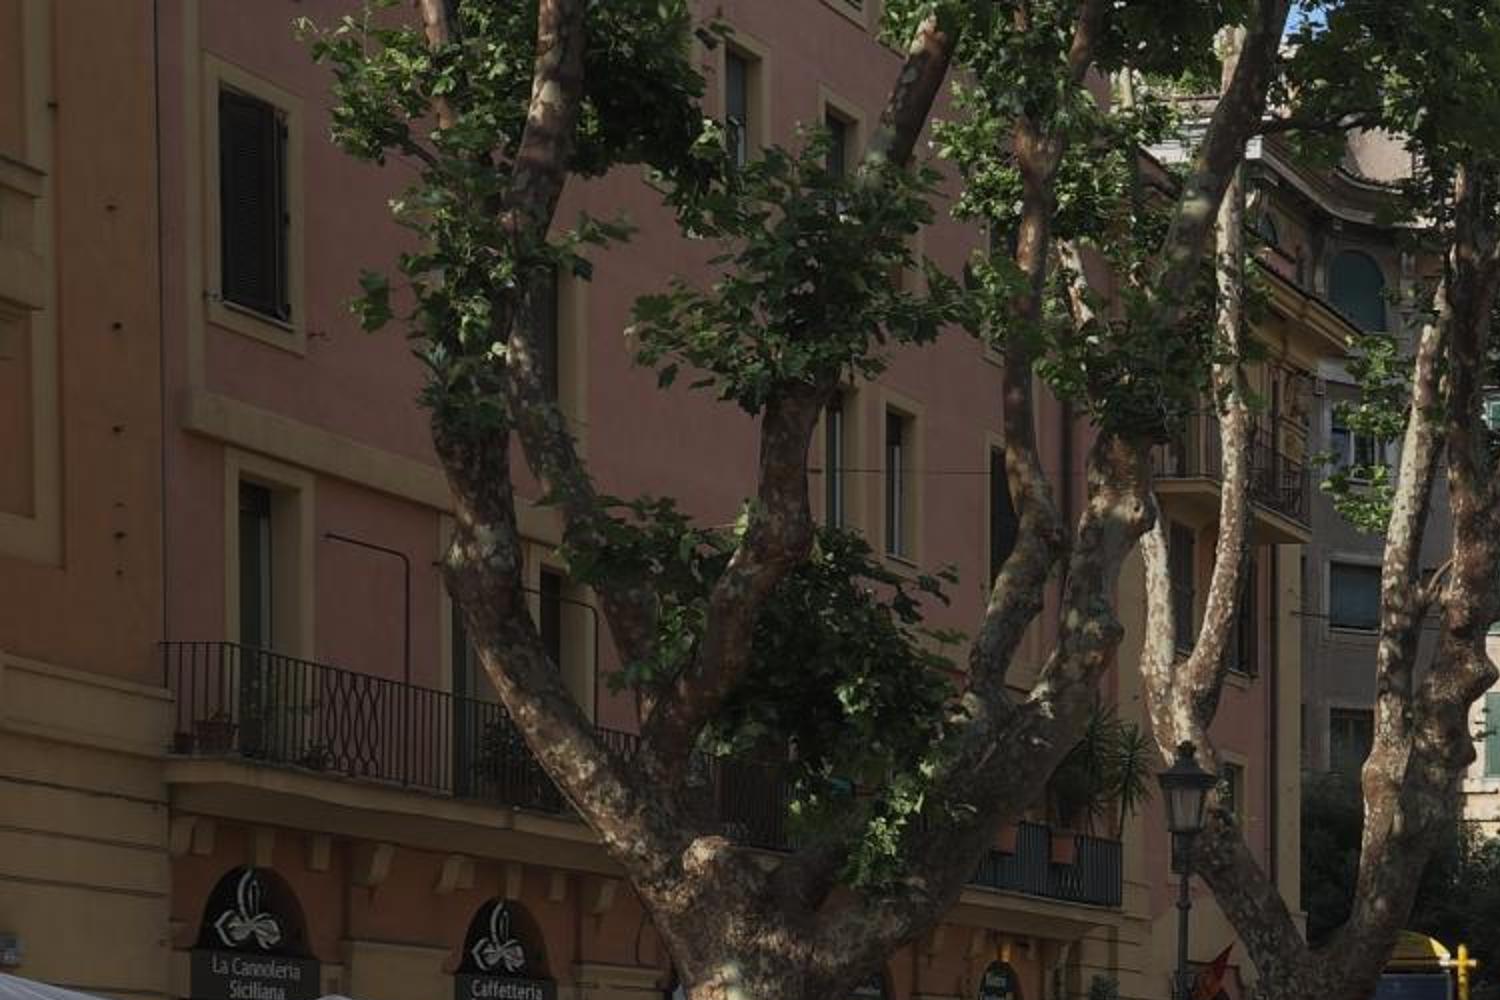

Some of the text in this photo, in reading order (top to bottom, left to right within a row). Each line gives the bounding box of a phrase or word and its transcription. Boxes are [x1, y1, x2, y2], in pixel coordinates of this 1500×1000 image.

[211, 954, 301, 980] La Cannoleria
[229, 979, 286, 1000] Siciliana
[472, 979, 543, 1000] Caffetteria
